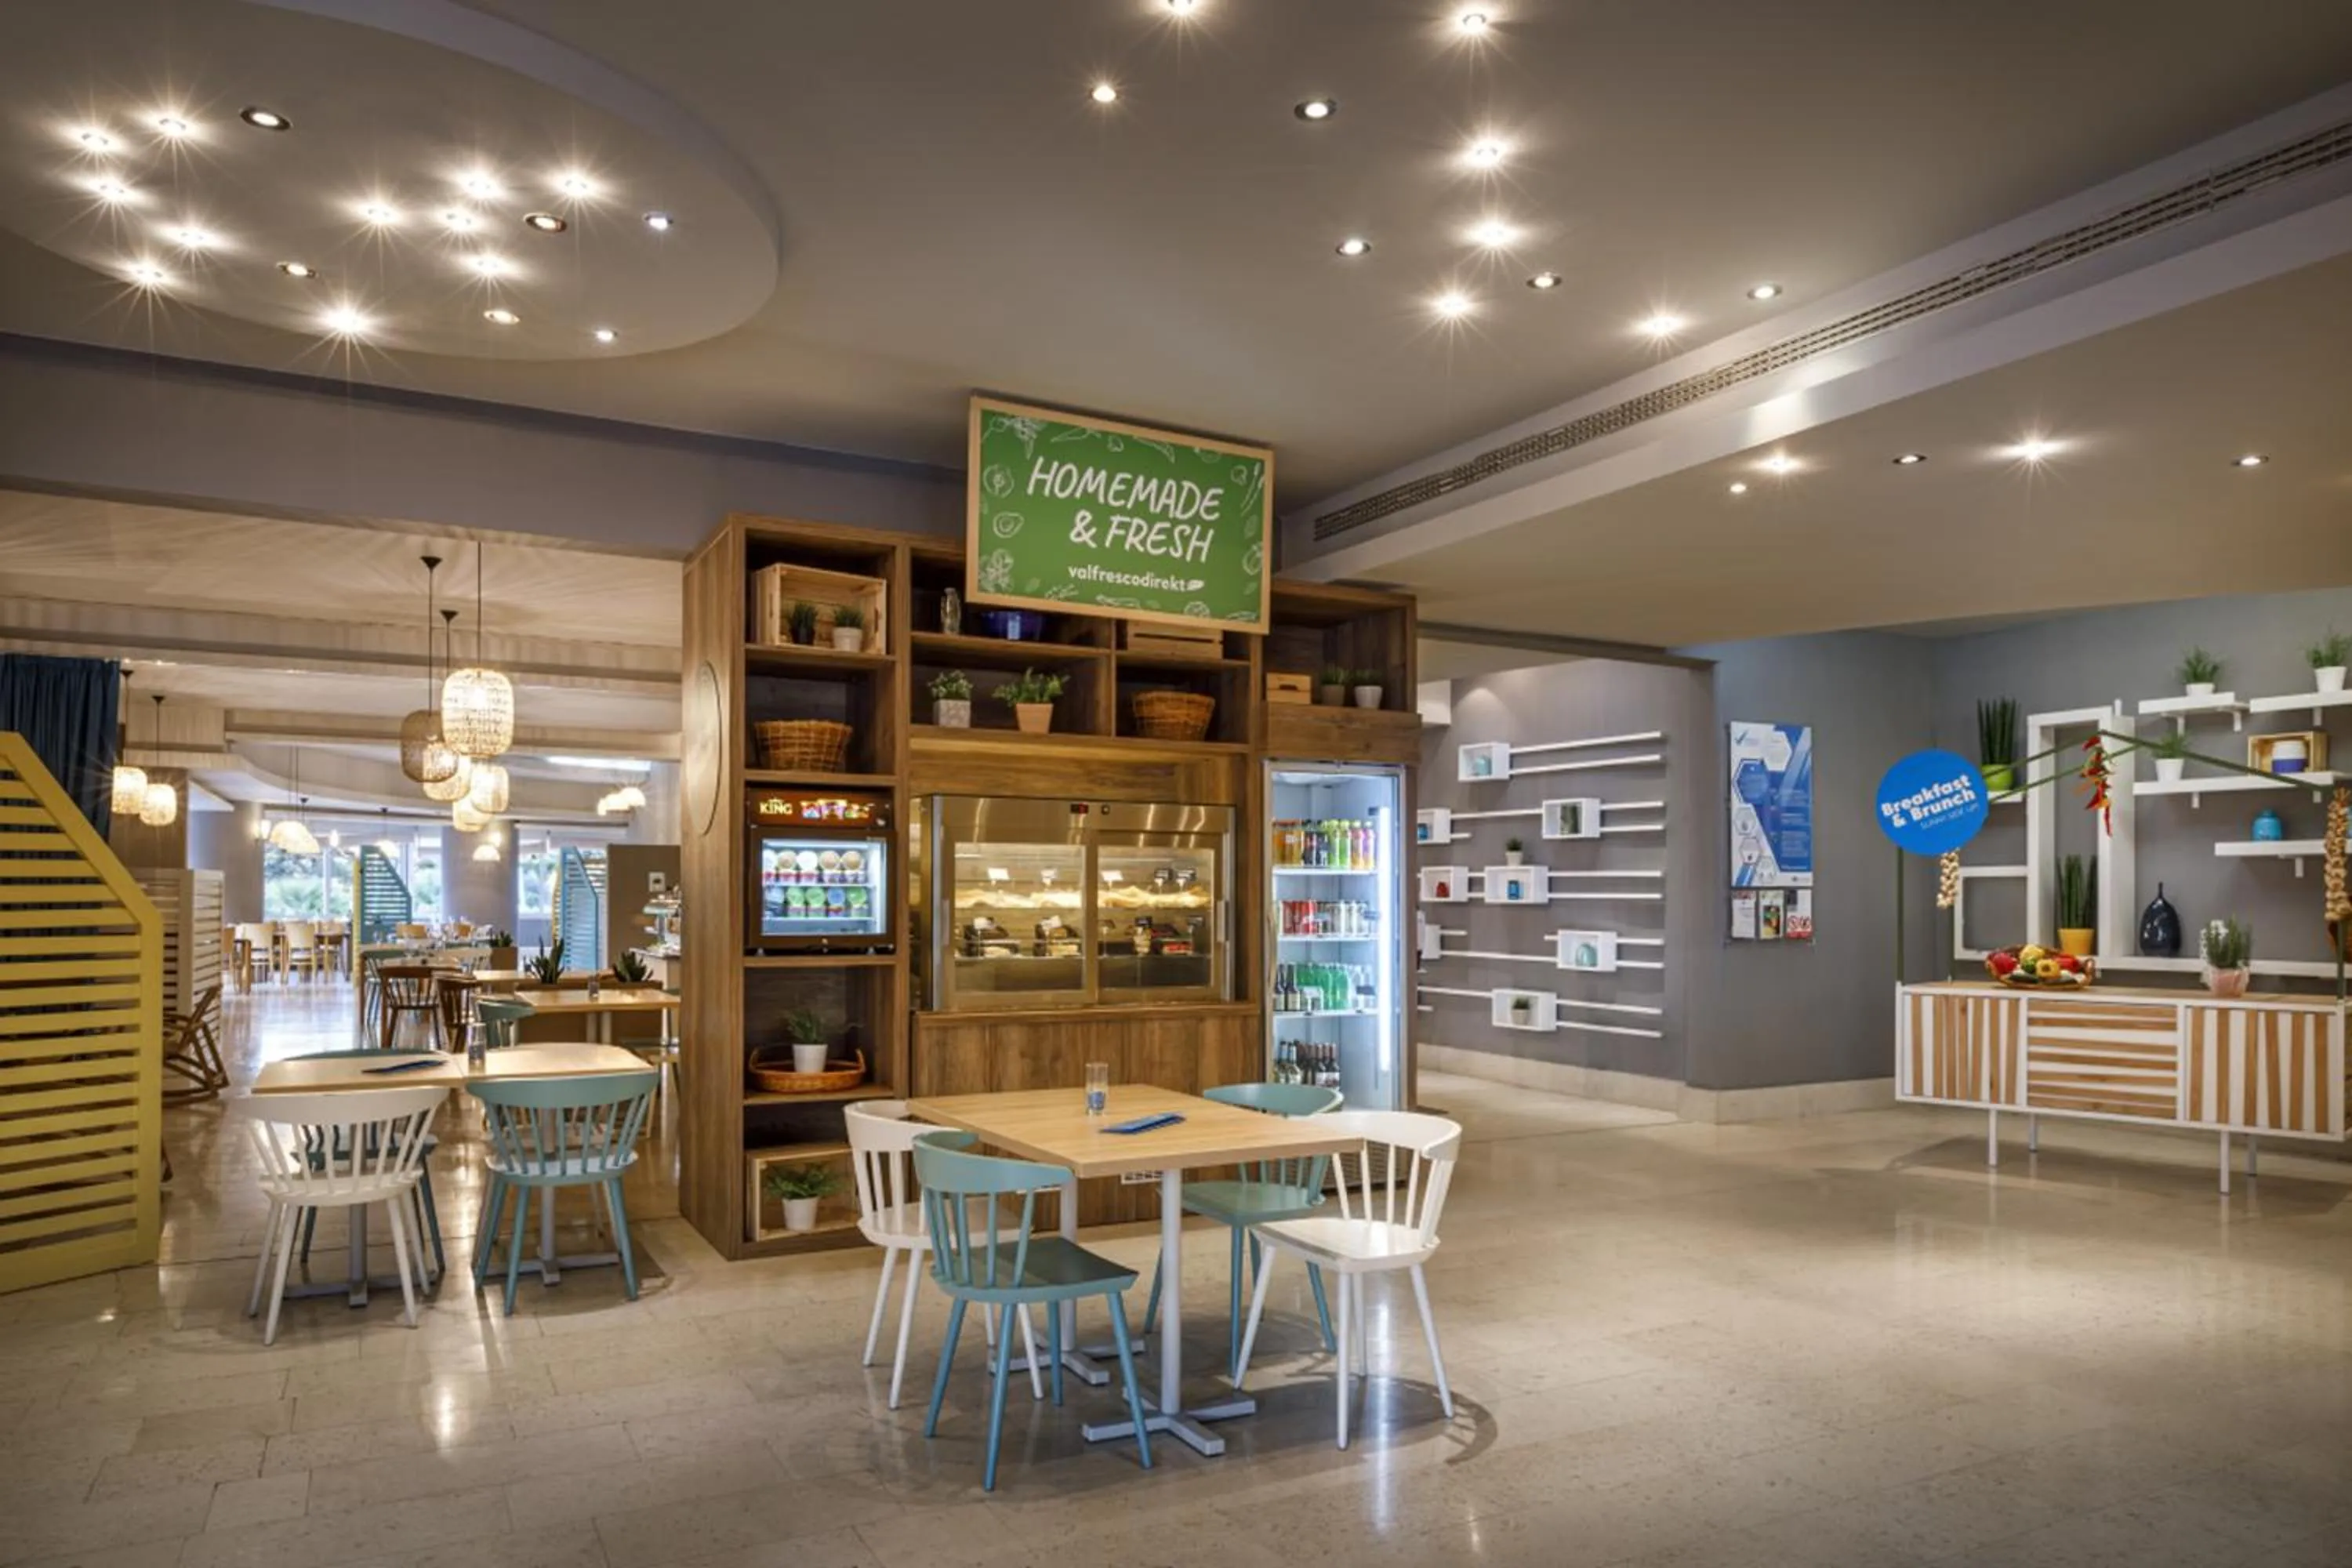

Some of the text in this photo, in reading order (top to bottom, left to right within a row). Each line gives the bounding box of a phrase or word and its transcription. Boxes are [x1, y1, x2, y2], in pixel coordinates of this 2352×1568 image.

[1026, 456, 1224, 521] HOMEMADE
[1069, 509, 1214, 564] & FRESH
[1068, 564, 1188, 593] valfrescodirekt
[759, 800, 793, 815] KING
[1882, 774, 1973, 816] Breakfast
[1910, 789, 1976, 822] Brunch
